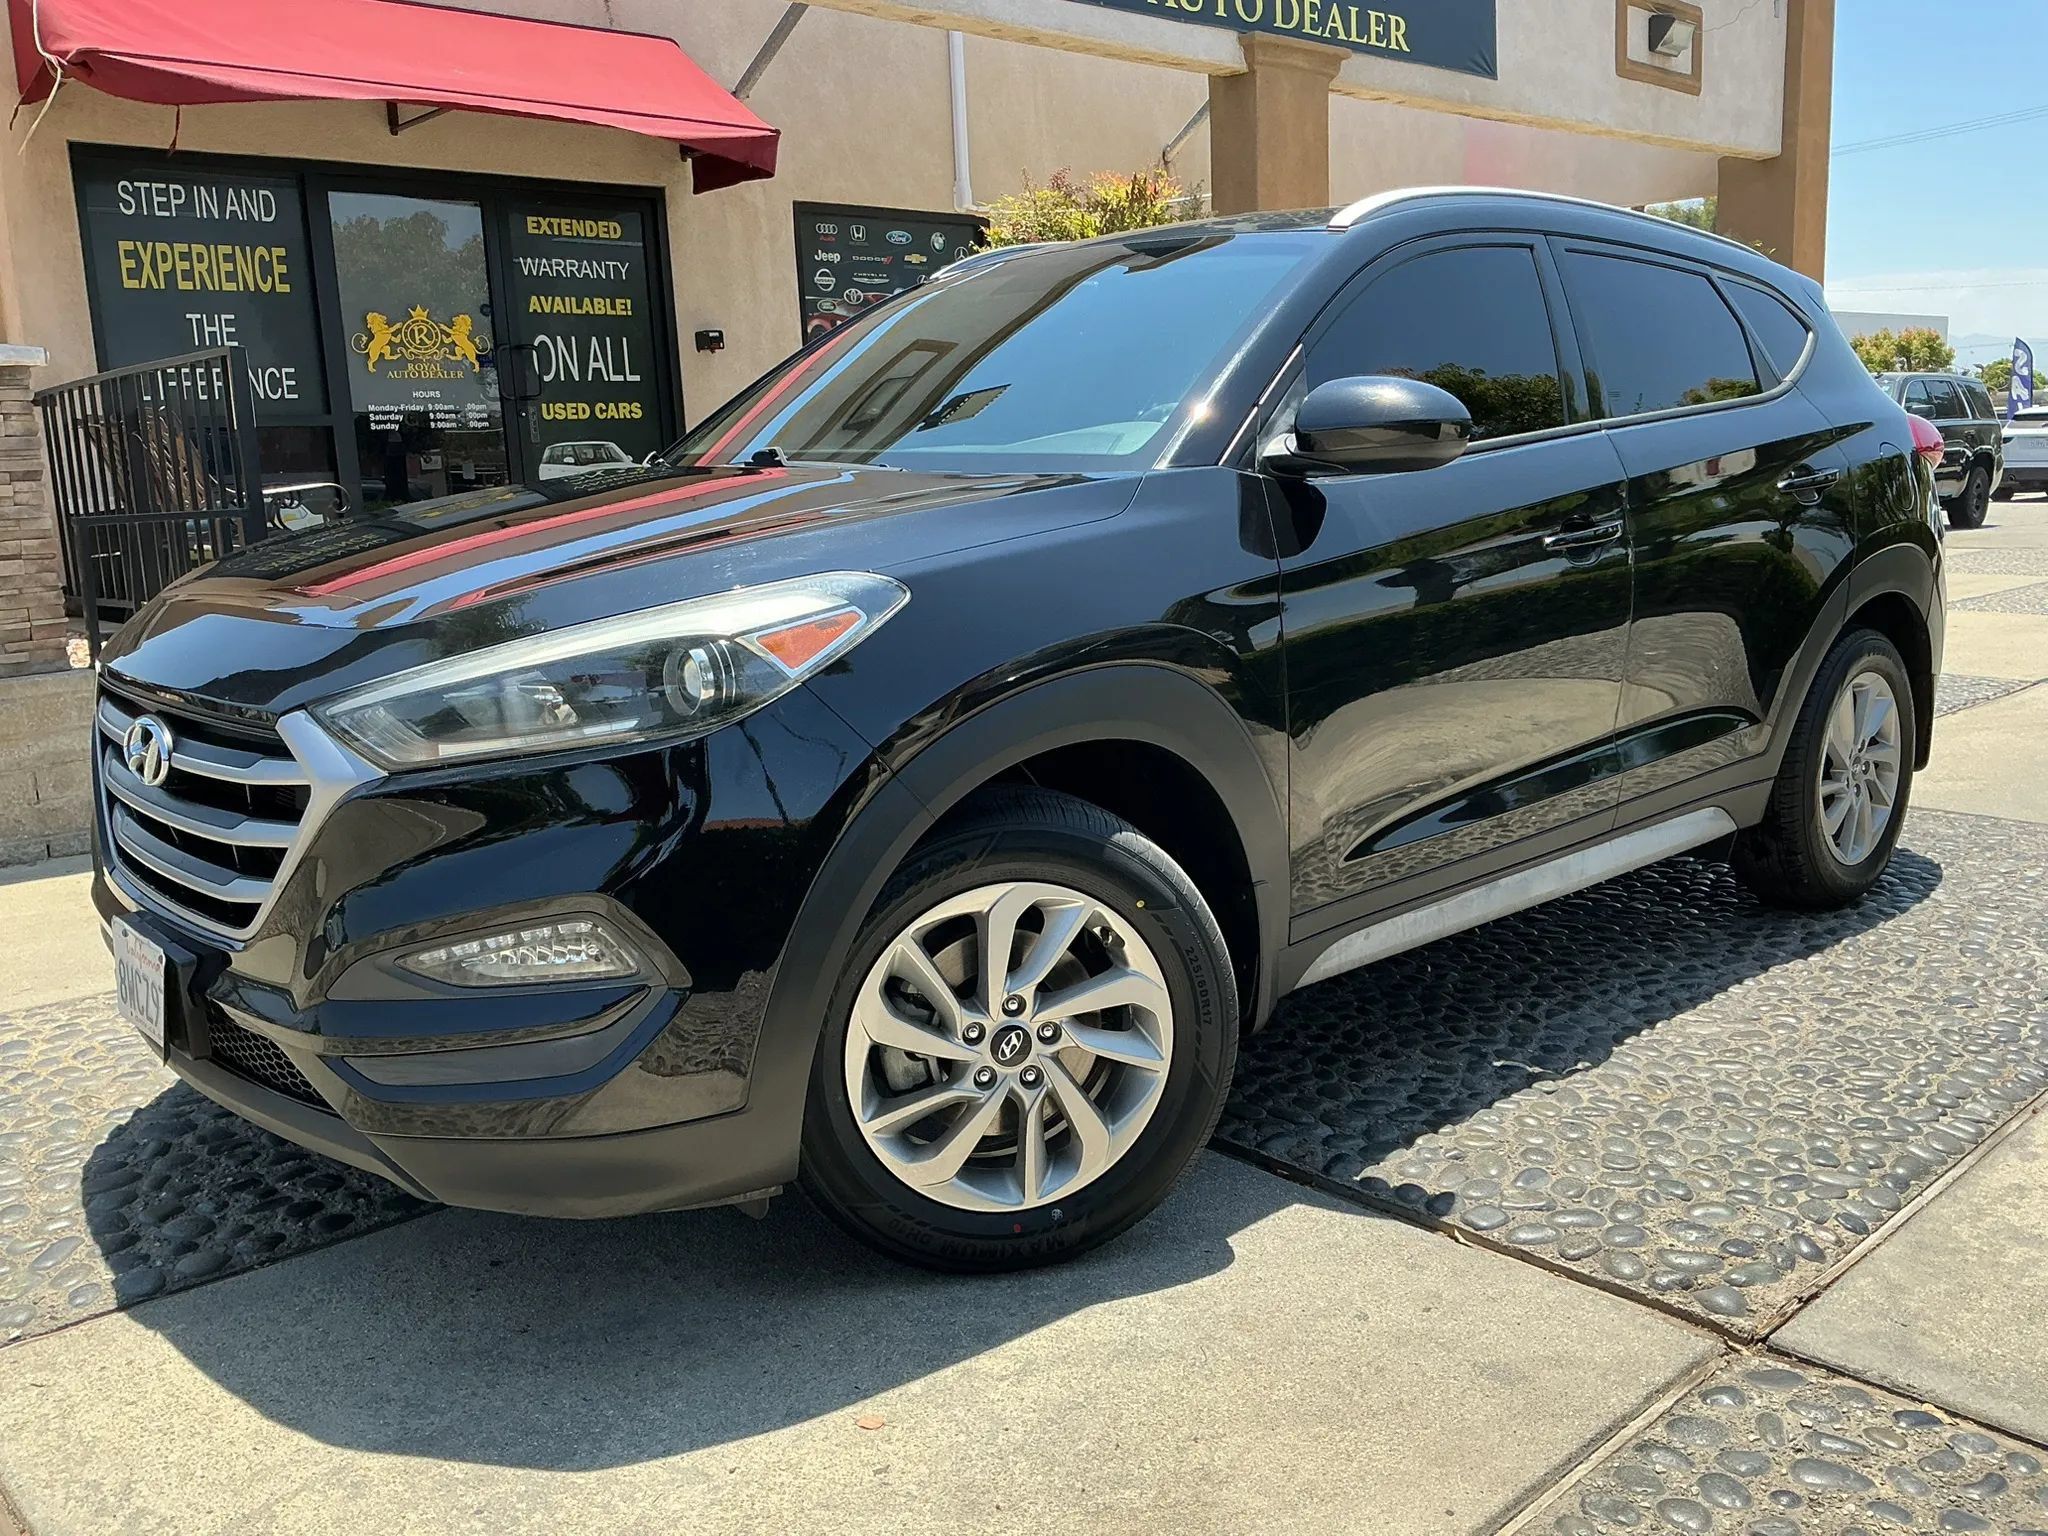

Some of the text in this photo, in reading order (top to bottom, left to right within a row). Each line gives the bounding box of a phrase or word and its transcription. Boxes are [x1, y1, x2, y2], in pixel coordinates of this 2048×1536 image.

[1273, 0, 1411, 52] DEALER
[117, 180, 276, 222] STEP IN AND
[526, 216, 622, 239] EXTENDED
[118, 240, 291, 293] EXPERIENCE
[814, 249, 841, 264] Jeep
[519, 256, 630, 280] WARRANTY
[528, 295, 633, 316] AVAILABLE!
[186, 313, 239, 347] THE
[412, 325, 432, 345] R
[407, 362, 442, 371] ROYAL
[532, 334, 641, 382] ON ALL
[387, 370, 465, 379] AUTO DEALER
[412, 390, 441, 398] HOURS
[367, 404, 424, 413] Monday-Friday
[427, 403, 455, 411] 9:00am
[369, 413, 404, 422] Saturday
[429, 412, 456, 420] 9:00am
[541, 402, 643, 420] USED CARS
[370, 422, 400, 431] Sunday
[430, 421, 457, 429] 9:00am
